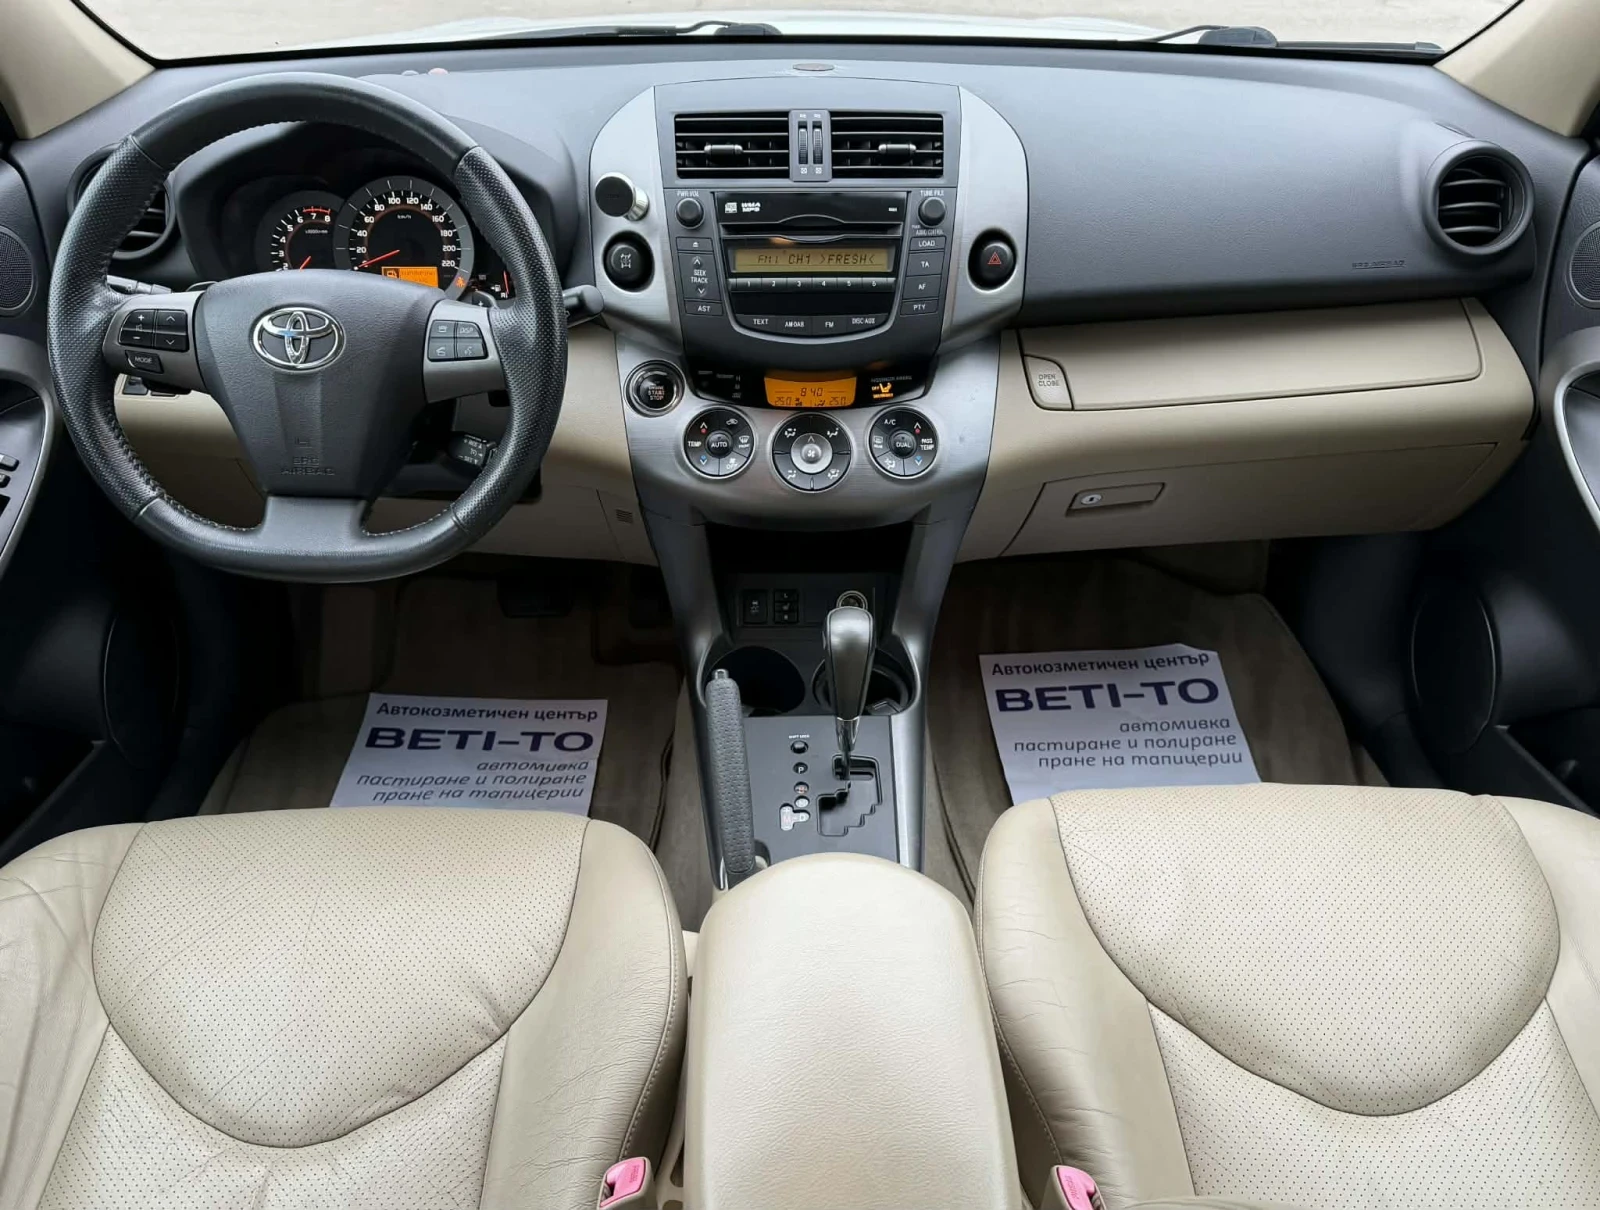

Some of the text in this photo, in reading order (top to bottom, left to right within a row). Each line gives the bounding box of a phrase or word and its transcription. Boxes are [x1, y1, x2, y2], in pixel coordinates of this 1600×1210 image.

[420, 203, 433, 211] 140
[788, 254, 811, 265] CH1
[690, 276, 709, 284] TRACK
[134, 355, 152, 364] MODE
[687, 440, 702, 448] TEMP
[710, 441, 728, 449] AUTO
[991, 652, 1211, 677] Автокозметичен център
[995, 677, 1220, 713] BETI-TO
[376, 702, 599, 723] Автокозметичен център
[1119, 716, 1231, 733] автомивка
[365, 726, 594, 753] BETI-TO
[1014, 733, 1237, 754] пастиране и полиране
[476, 759, 590, 773] автомивка
[1038, 751, 1244, 770] пране на тапицерии
[798, 766, 804, 774] P
[356, 773, 588, 789] пастиране и полиране
[371, 787, 585, 803] пране на тапицерии
